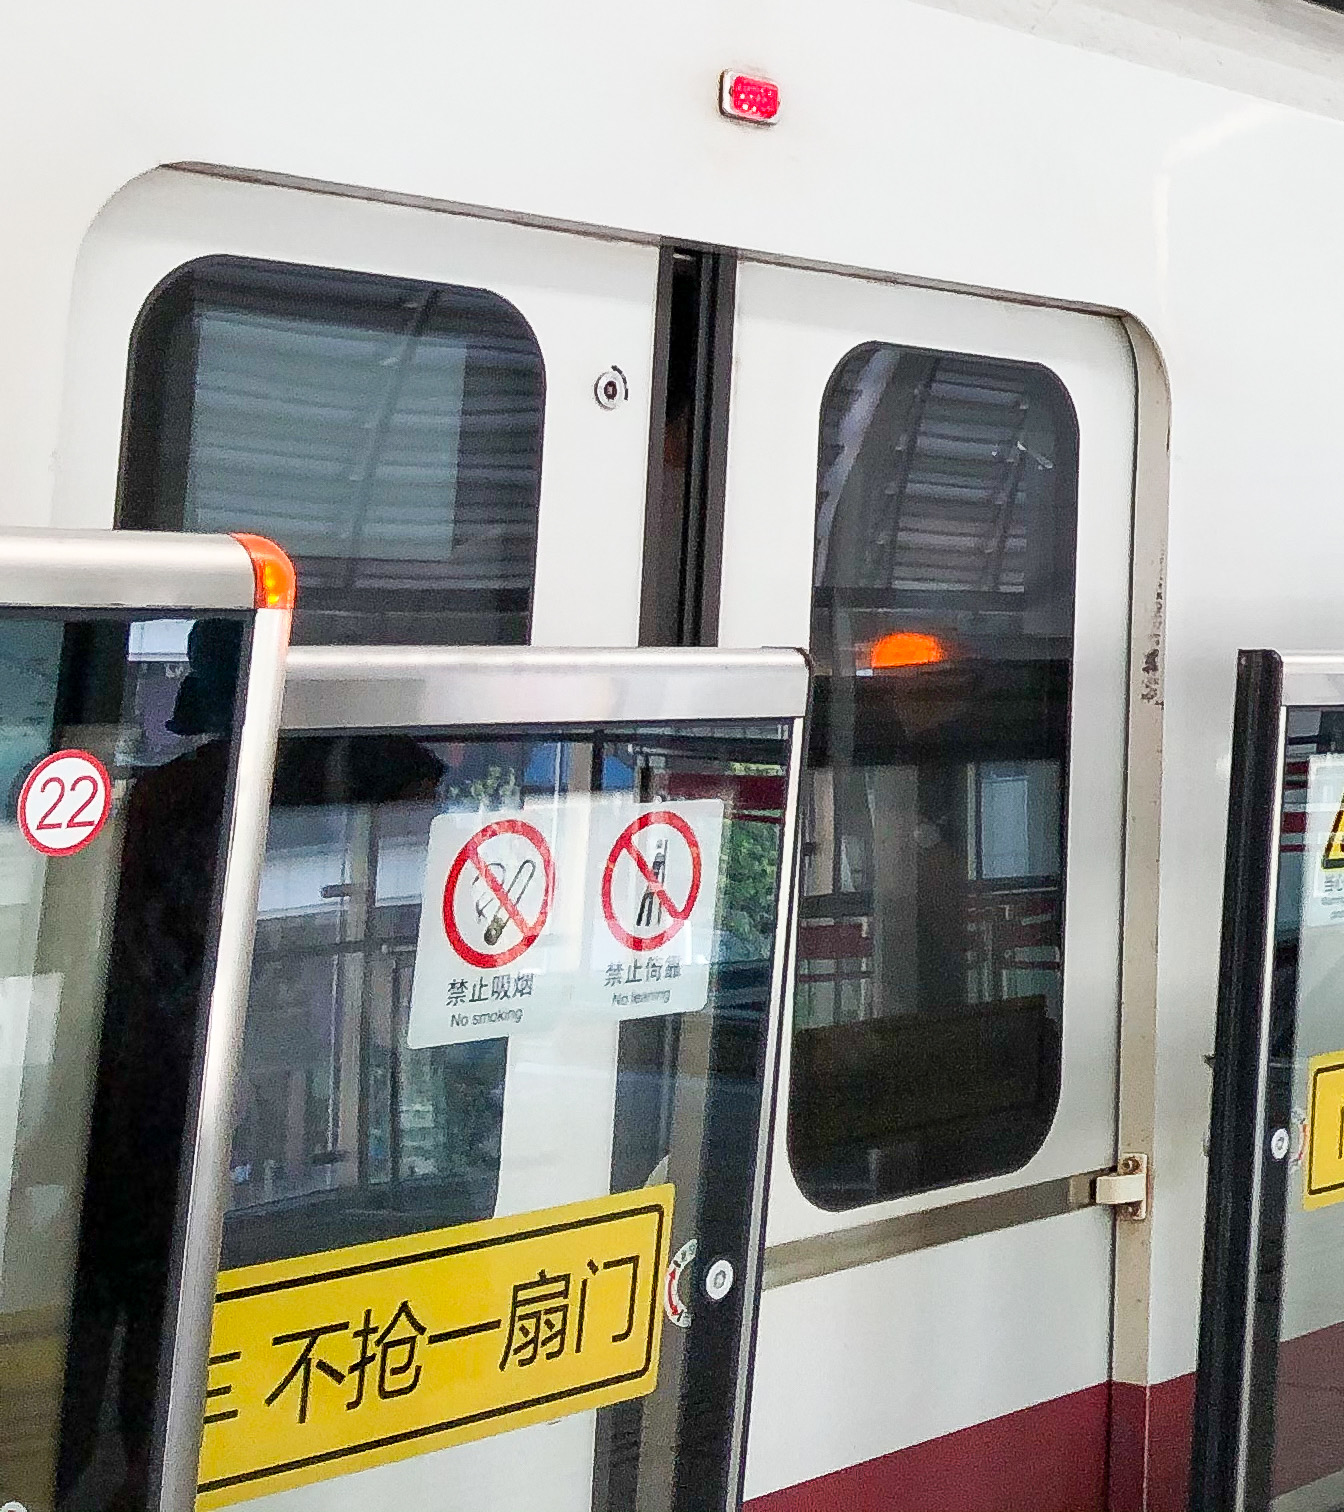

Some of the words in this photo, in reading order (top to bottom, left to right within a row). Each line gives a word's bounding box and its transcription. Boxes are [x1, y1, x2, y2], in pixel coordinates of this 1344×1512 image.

[36, 775, 98, 830] 22
[446, 972, 535, 1007] 禁止吸烟
[450, 1013, 469, 1028] No
[472, 1008, 524, 1026] smoking
[264, 1253, 642, 1425] 不抢一扇门
